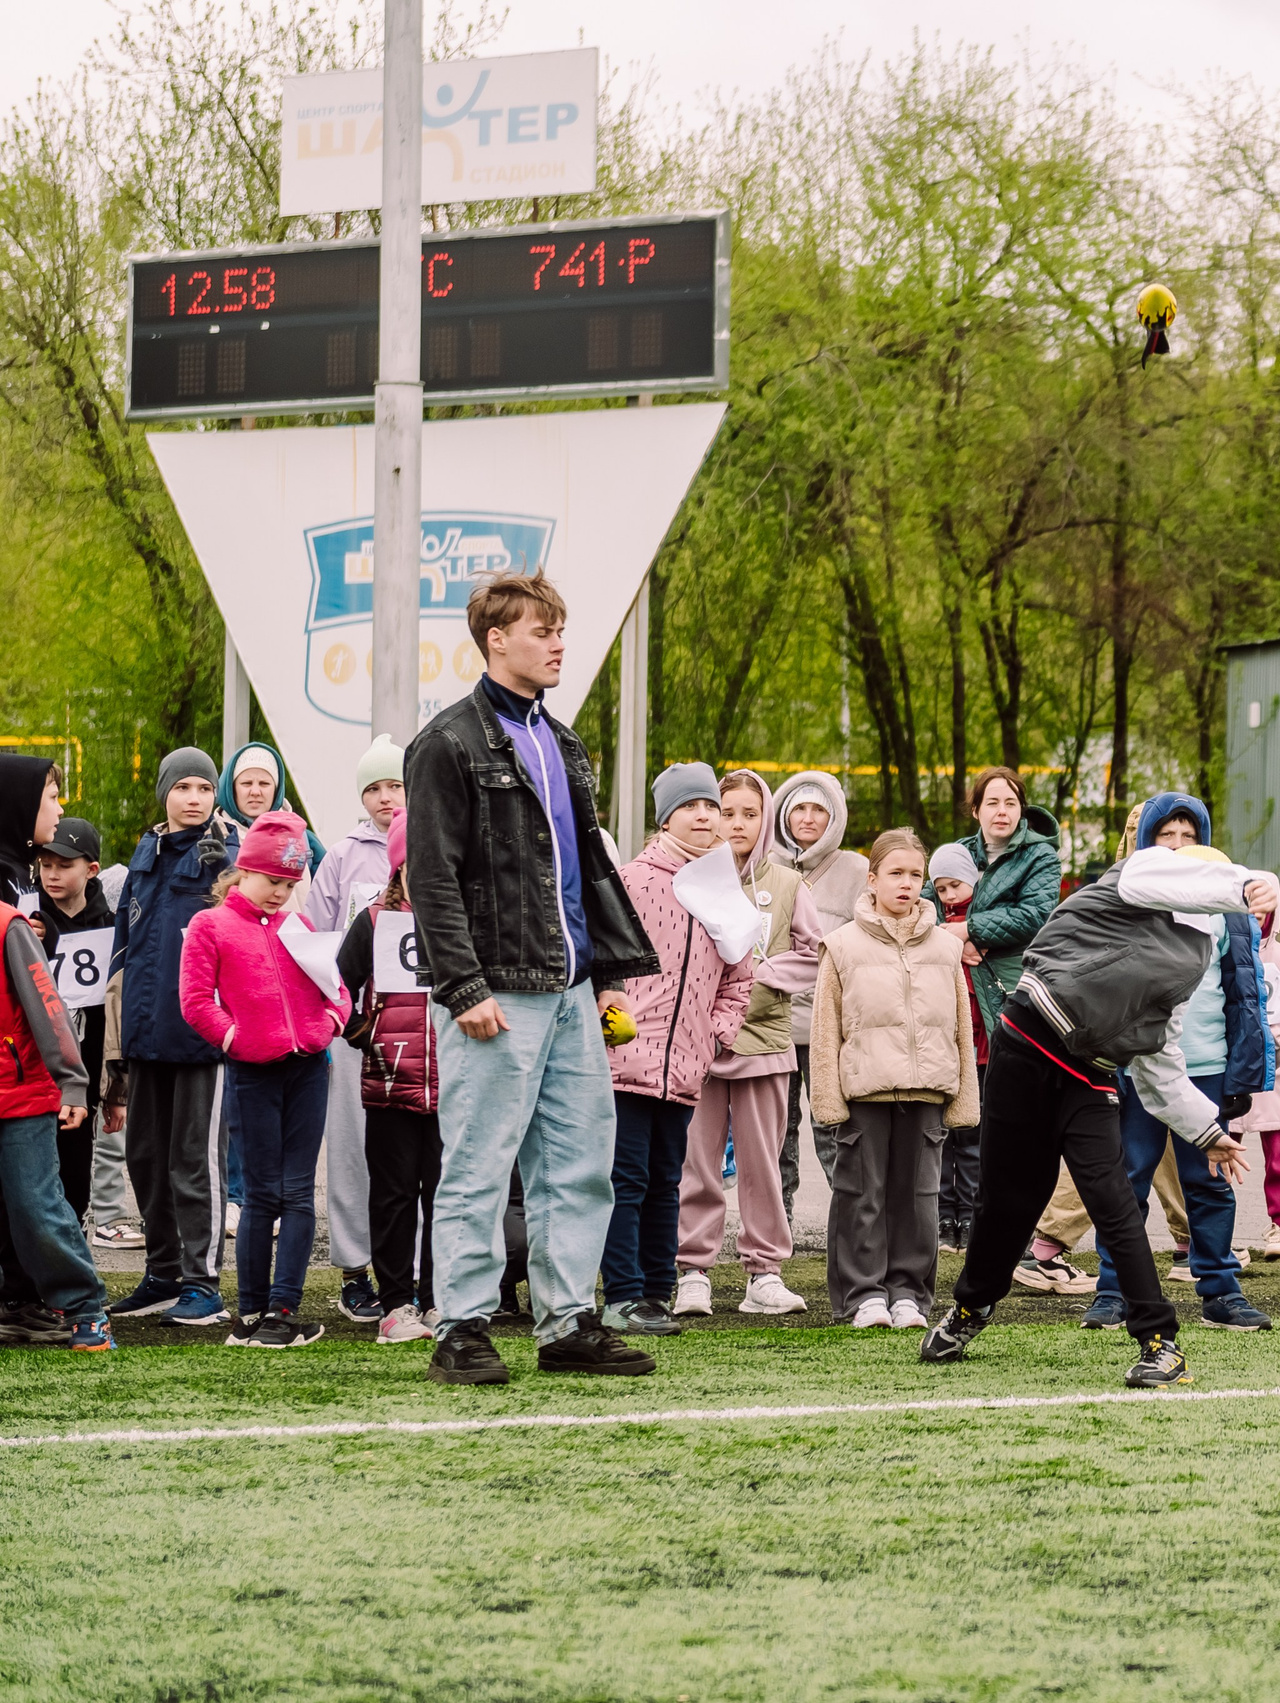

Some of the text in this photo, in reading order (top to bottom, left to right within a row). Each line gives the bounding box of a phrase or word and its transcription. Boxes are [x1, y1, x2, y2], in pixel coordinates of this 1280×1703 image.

[297, 106, 336, 120] ЦЕНТР
[470, 162, 566, 184] СТАДИОН
[161, 266, 276, 316] 12.58
[28, 961, 64, 1018] NIKE
